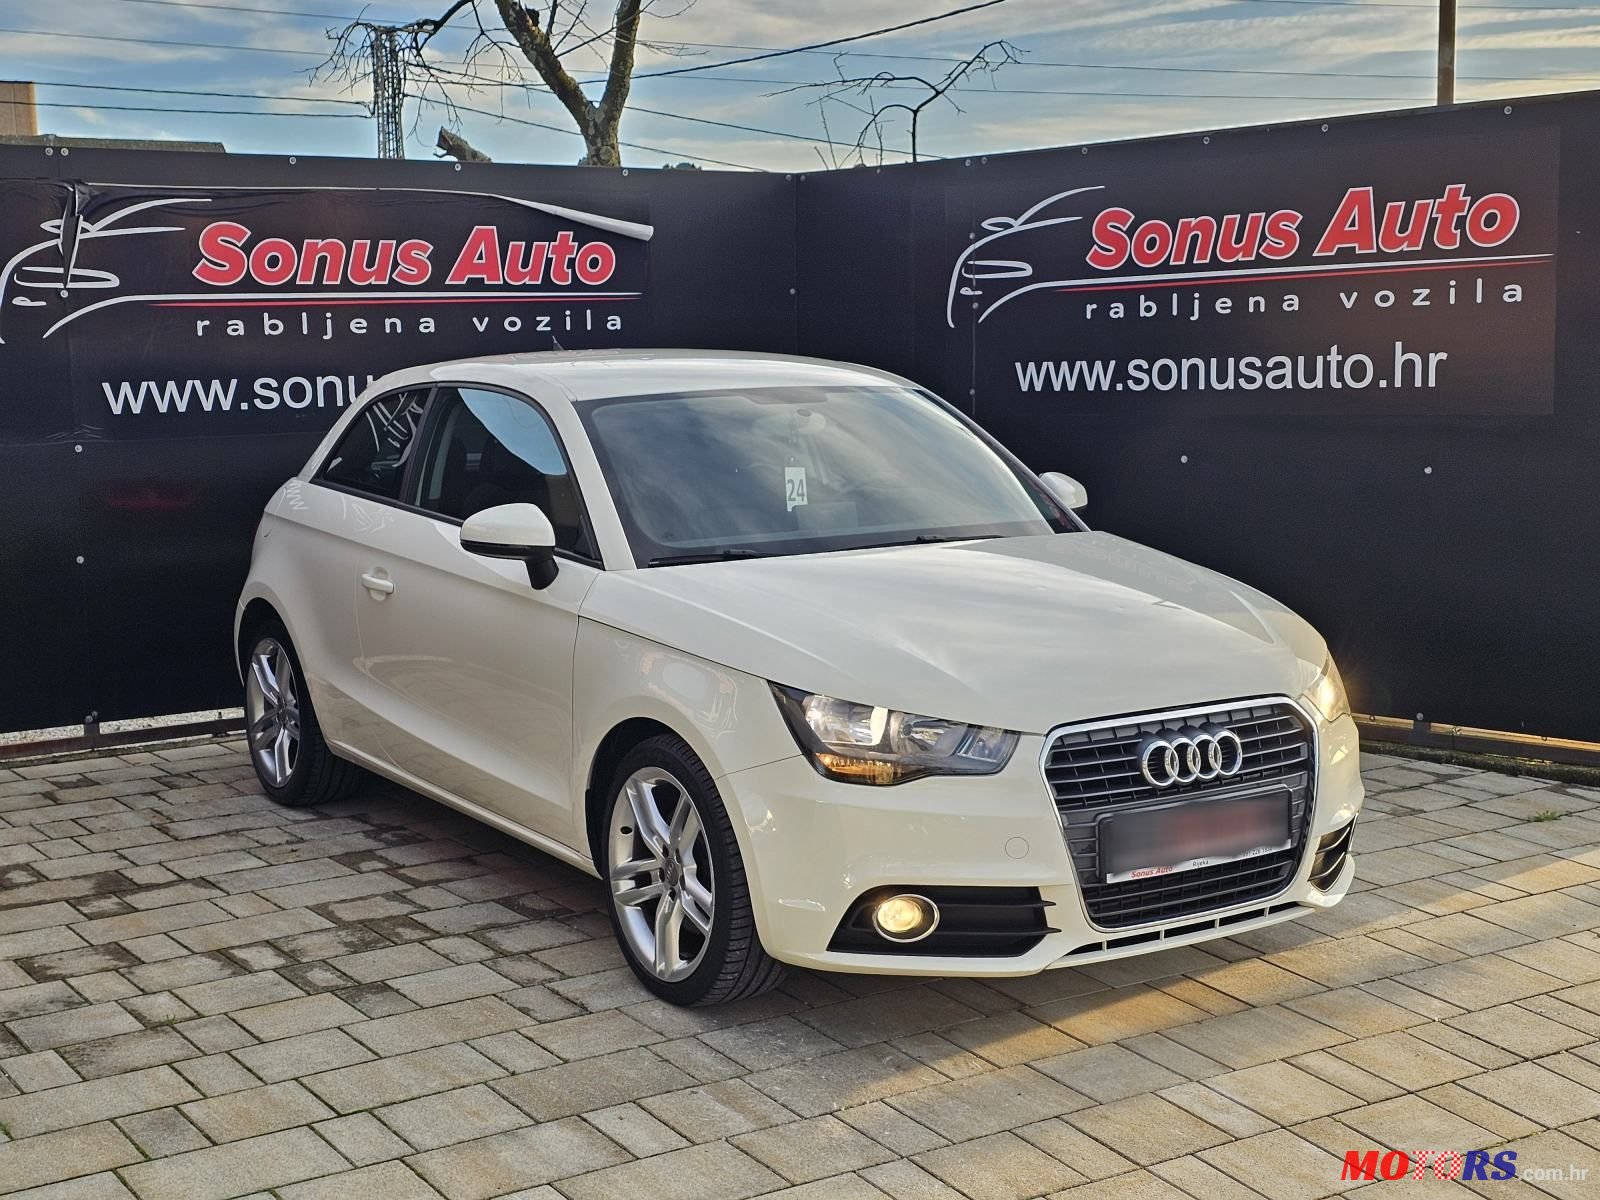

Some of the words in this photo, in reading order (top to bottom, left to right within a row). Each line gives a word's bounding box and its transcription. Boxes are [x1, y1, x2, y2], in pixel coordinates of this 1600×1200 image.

[1086, 206, 1302, 270] Sonus
[1312, 184, 1520, 253] Auto
[192, 220, 433, 287] Sonus
[445, 225, 617, 286] Auto
[1086, 292, 1300, 321] rabljena
[1339, 278, 1524, 309] vozila
[196, 311, 435, 340] rabljena
[472, 308, 622, 333] vozila
[1014, 341, 1448, 393] www.sonusauto.hr
[786, 478, 806, 502] 24
